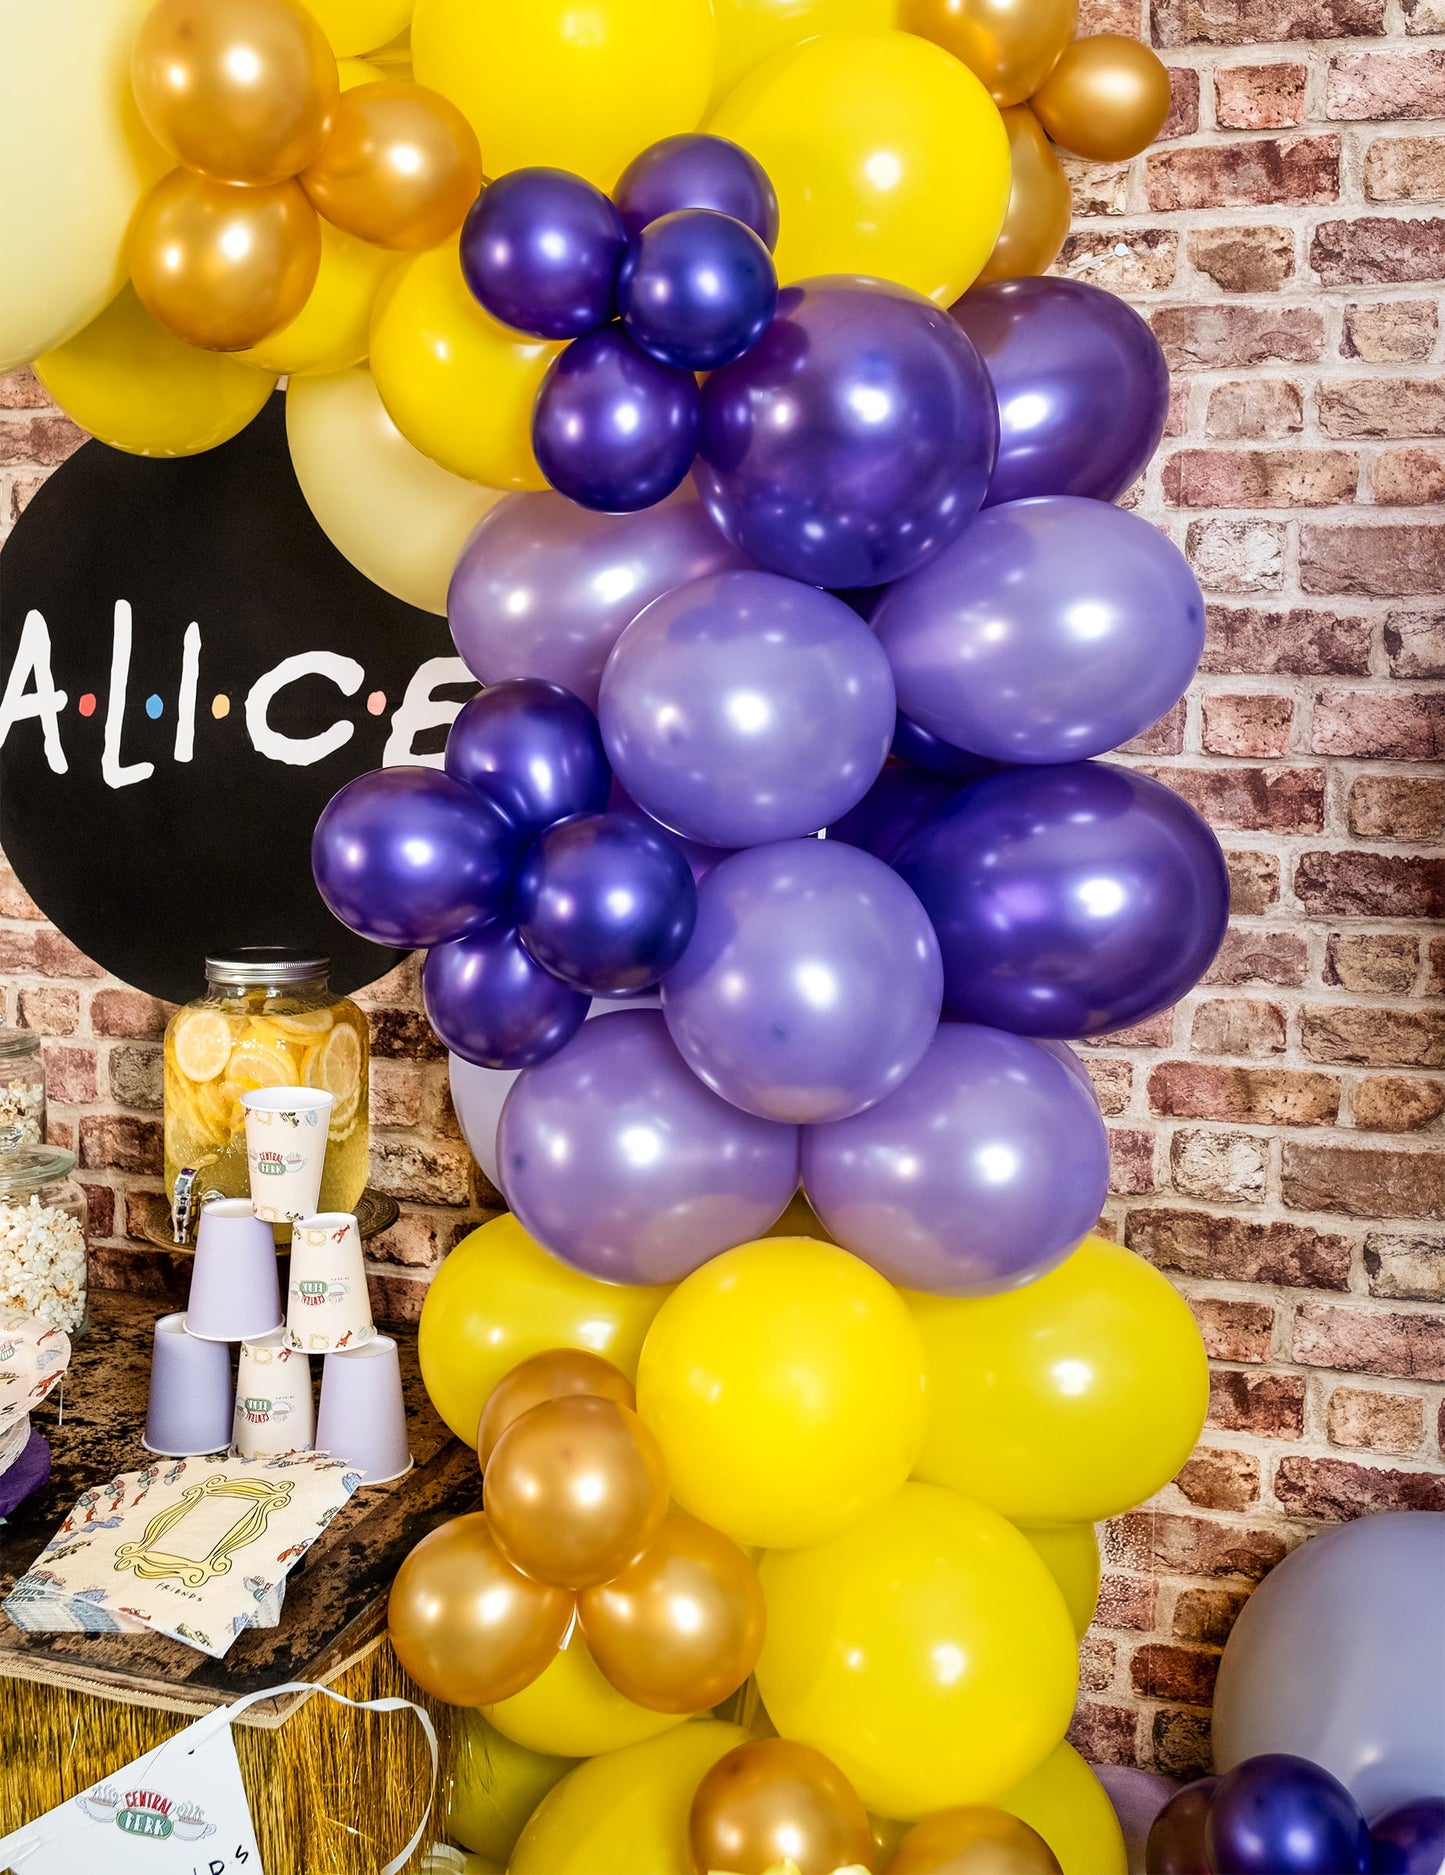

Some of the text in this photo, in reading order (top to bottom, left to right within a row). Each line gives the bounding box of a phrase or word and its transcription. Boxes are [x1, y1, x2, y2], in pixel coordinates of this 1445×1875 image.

[154, 1582, 203, 1602] FRIENDS
[124, 1790, 173, 1816] CENTRAL
[125, 1811, 166, 1837] PERK
